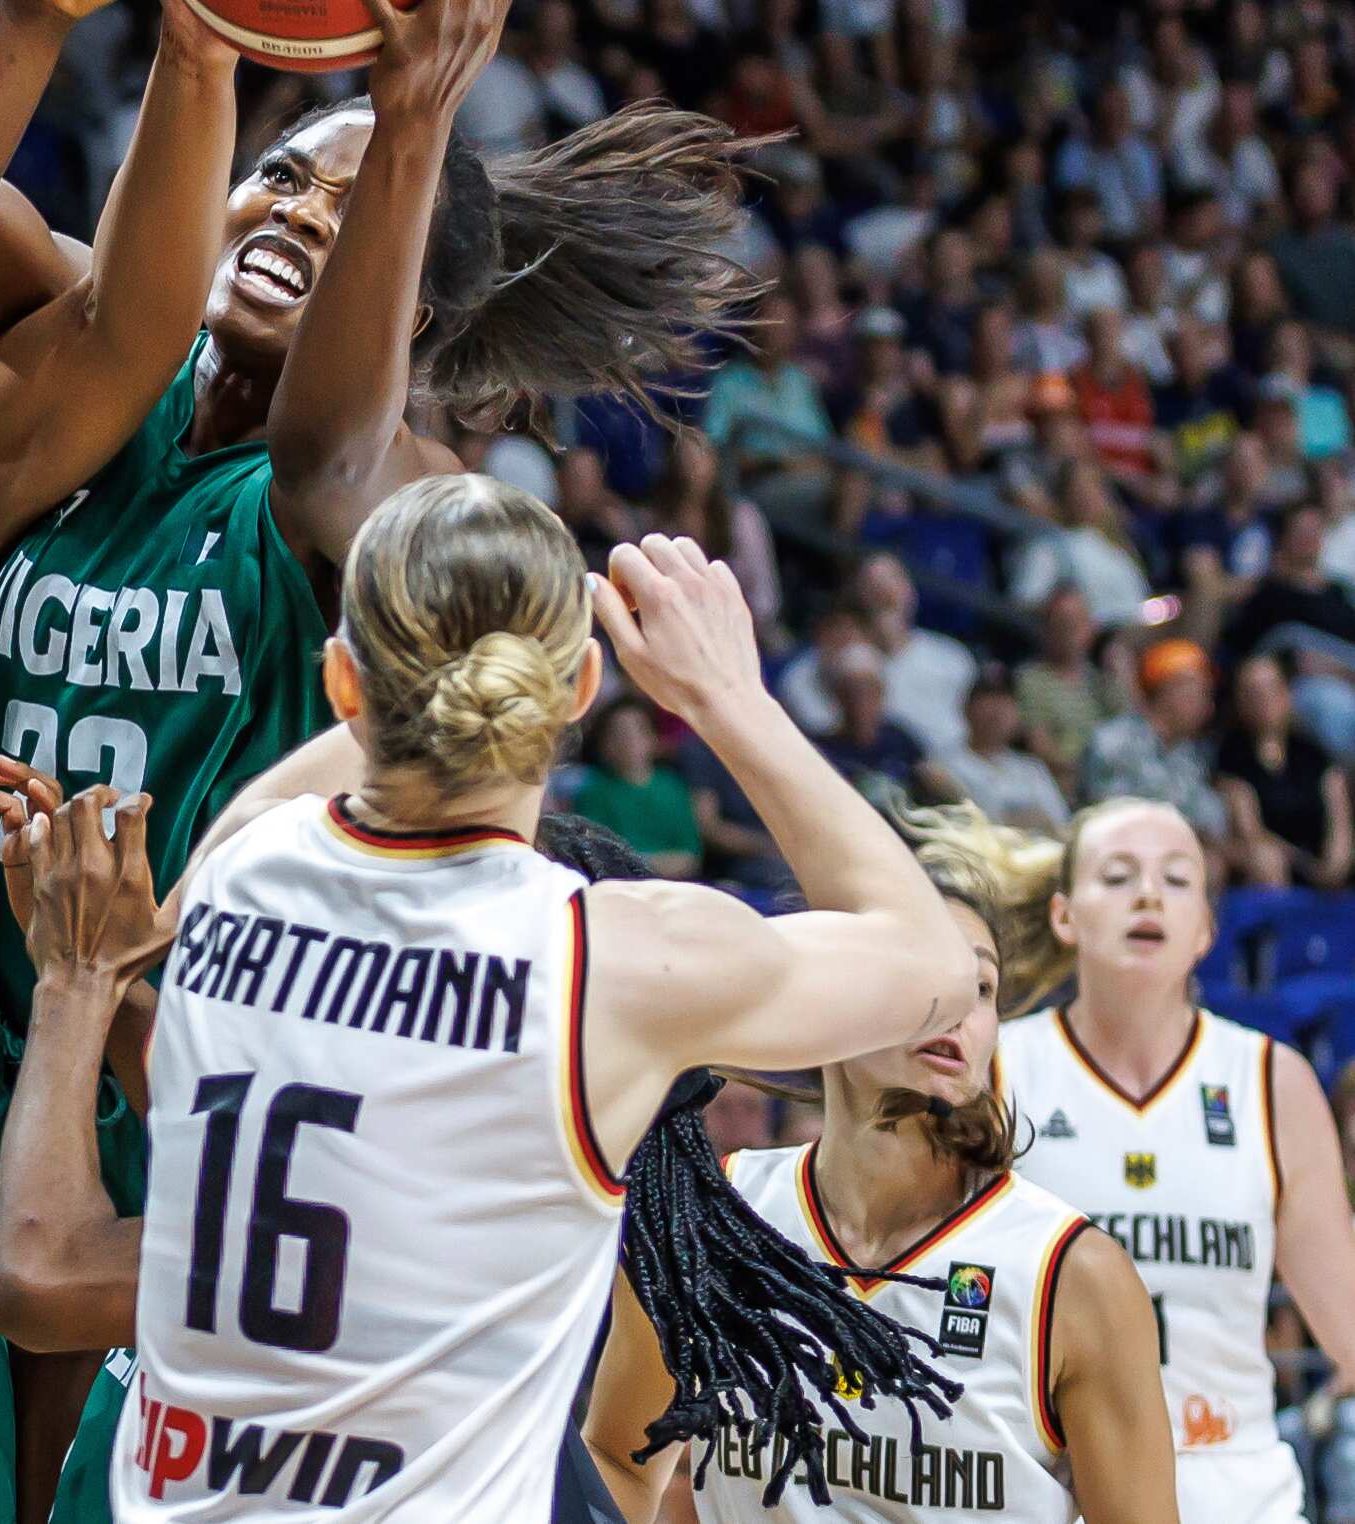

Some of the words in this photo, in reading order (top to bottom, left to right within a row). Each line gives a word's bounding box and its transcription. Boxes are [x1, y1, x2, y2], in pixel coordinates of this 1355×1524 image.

[175, 901, 533, 1054] HARTMANN
[185, 1071, 365, 1355] 16
[947, 1314, 981, 1336] FIBA
